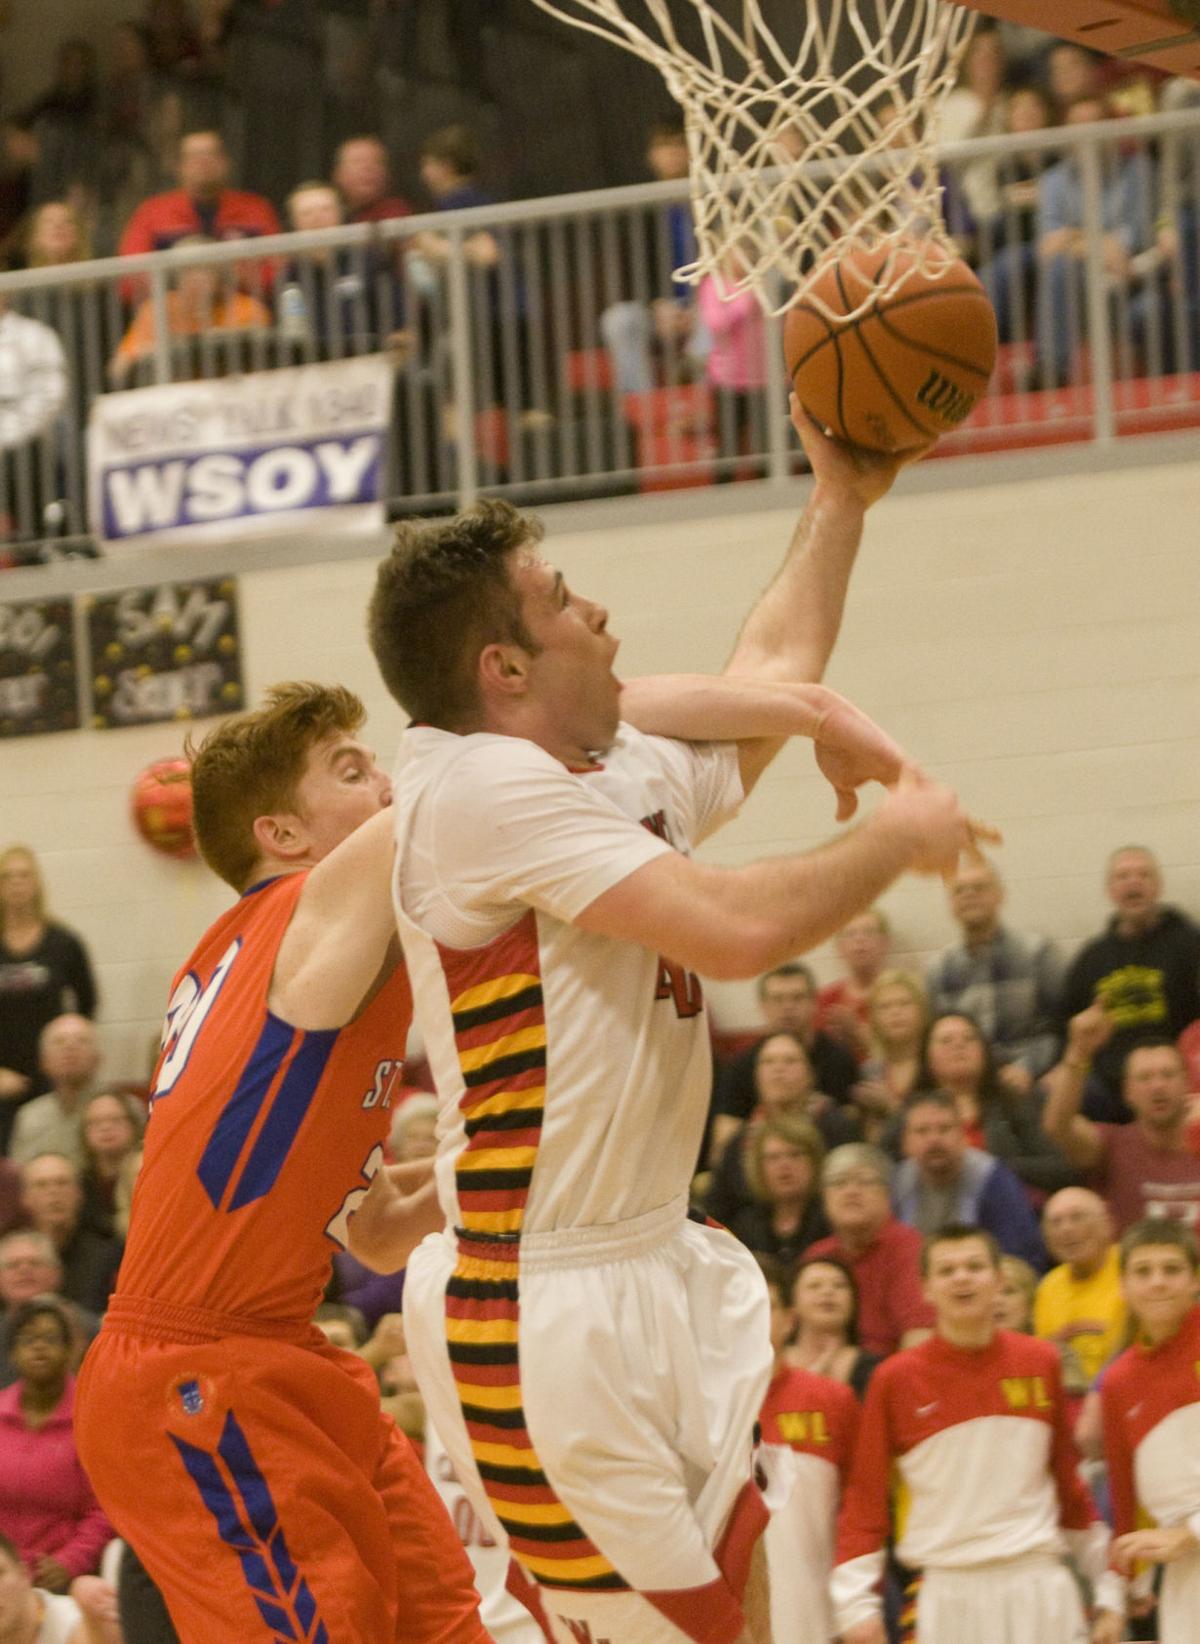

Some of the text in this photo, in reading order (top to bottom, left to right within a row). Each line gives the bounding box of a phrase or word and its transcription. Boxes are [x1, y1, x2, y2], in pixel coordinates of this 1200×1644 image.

[107, 434, 379, 535] WSOY
[1001, 1376, 1051, 1409] WL
[776, 1411, 830, 1444] WL
